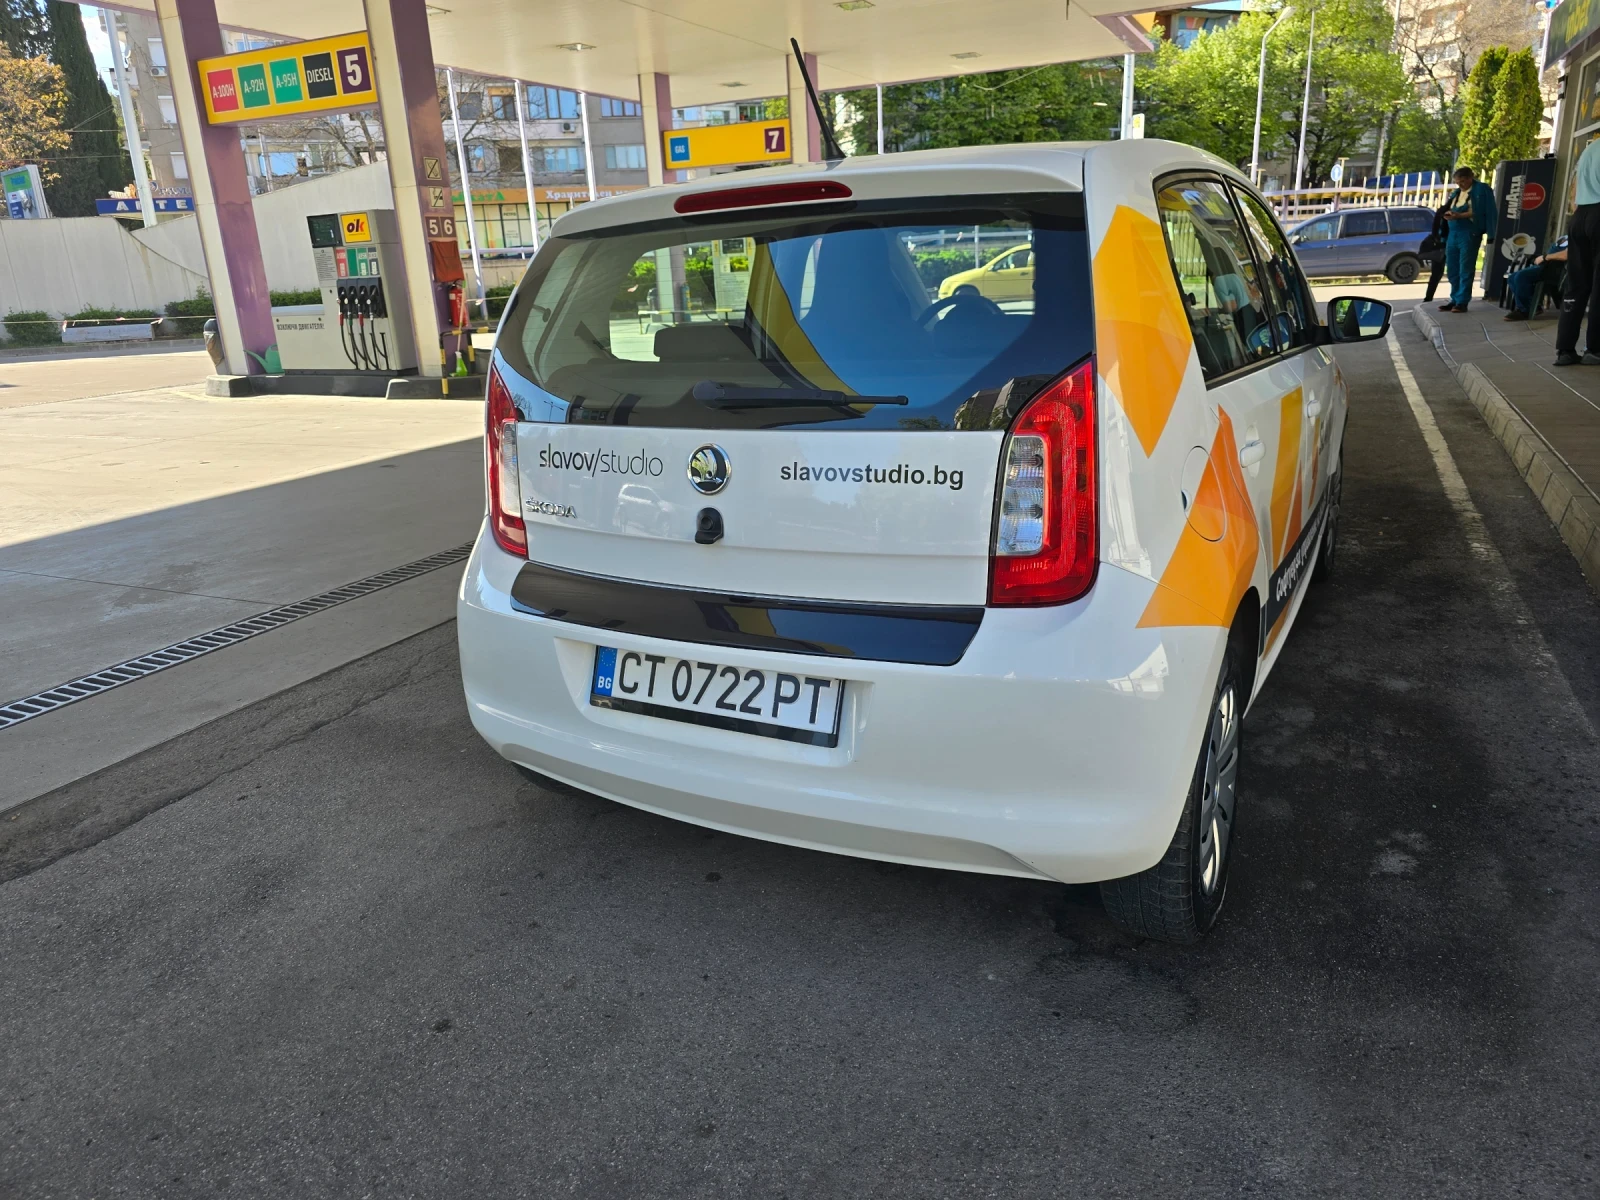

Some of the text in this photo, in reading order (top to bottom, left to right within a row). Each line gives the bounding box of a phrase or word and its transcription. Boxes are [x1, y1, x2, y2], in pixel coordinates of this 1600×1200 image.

[306, 67, 333, 84] DIESEL
[344, 54, 363, 86] 5
[244, 78, 266, 93] A-92H
[276, 73, 298, 88] A-95H
[213, 84, 236, 98] A-100H
[768, 130, 780, 150] 7
[674, 145, 686, 154] GAS
[1506, 175, 1522, 219] LAVAZZA
[429, 219, 453, 235] 5 6
[539, 443, 663, 477] slavov/studio
[780, 461, 964, 491] slavovstudio.bg
[597, 652, 832, 724] BG CT 0722 PT
